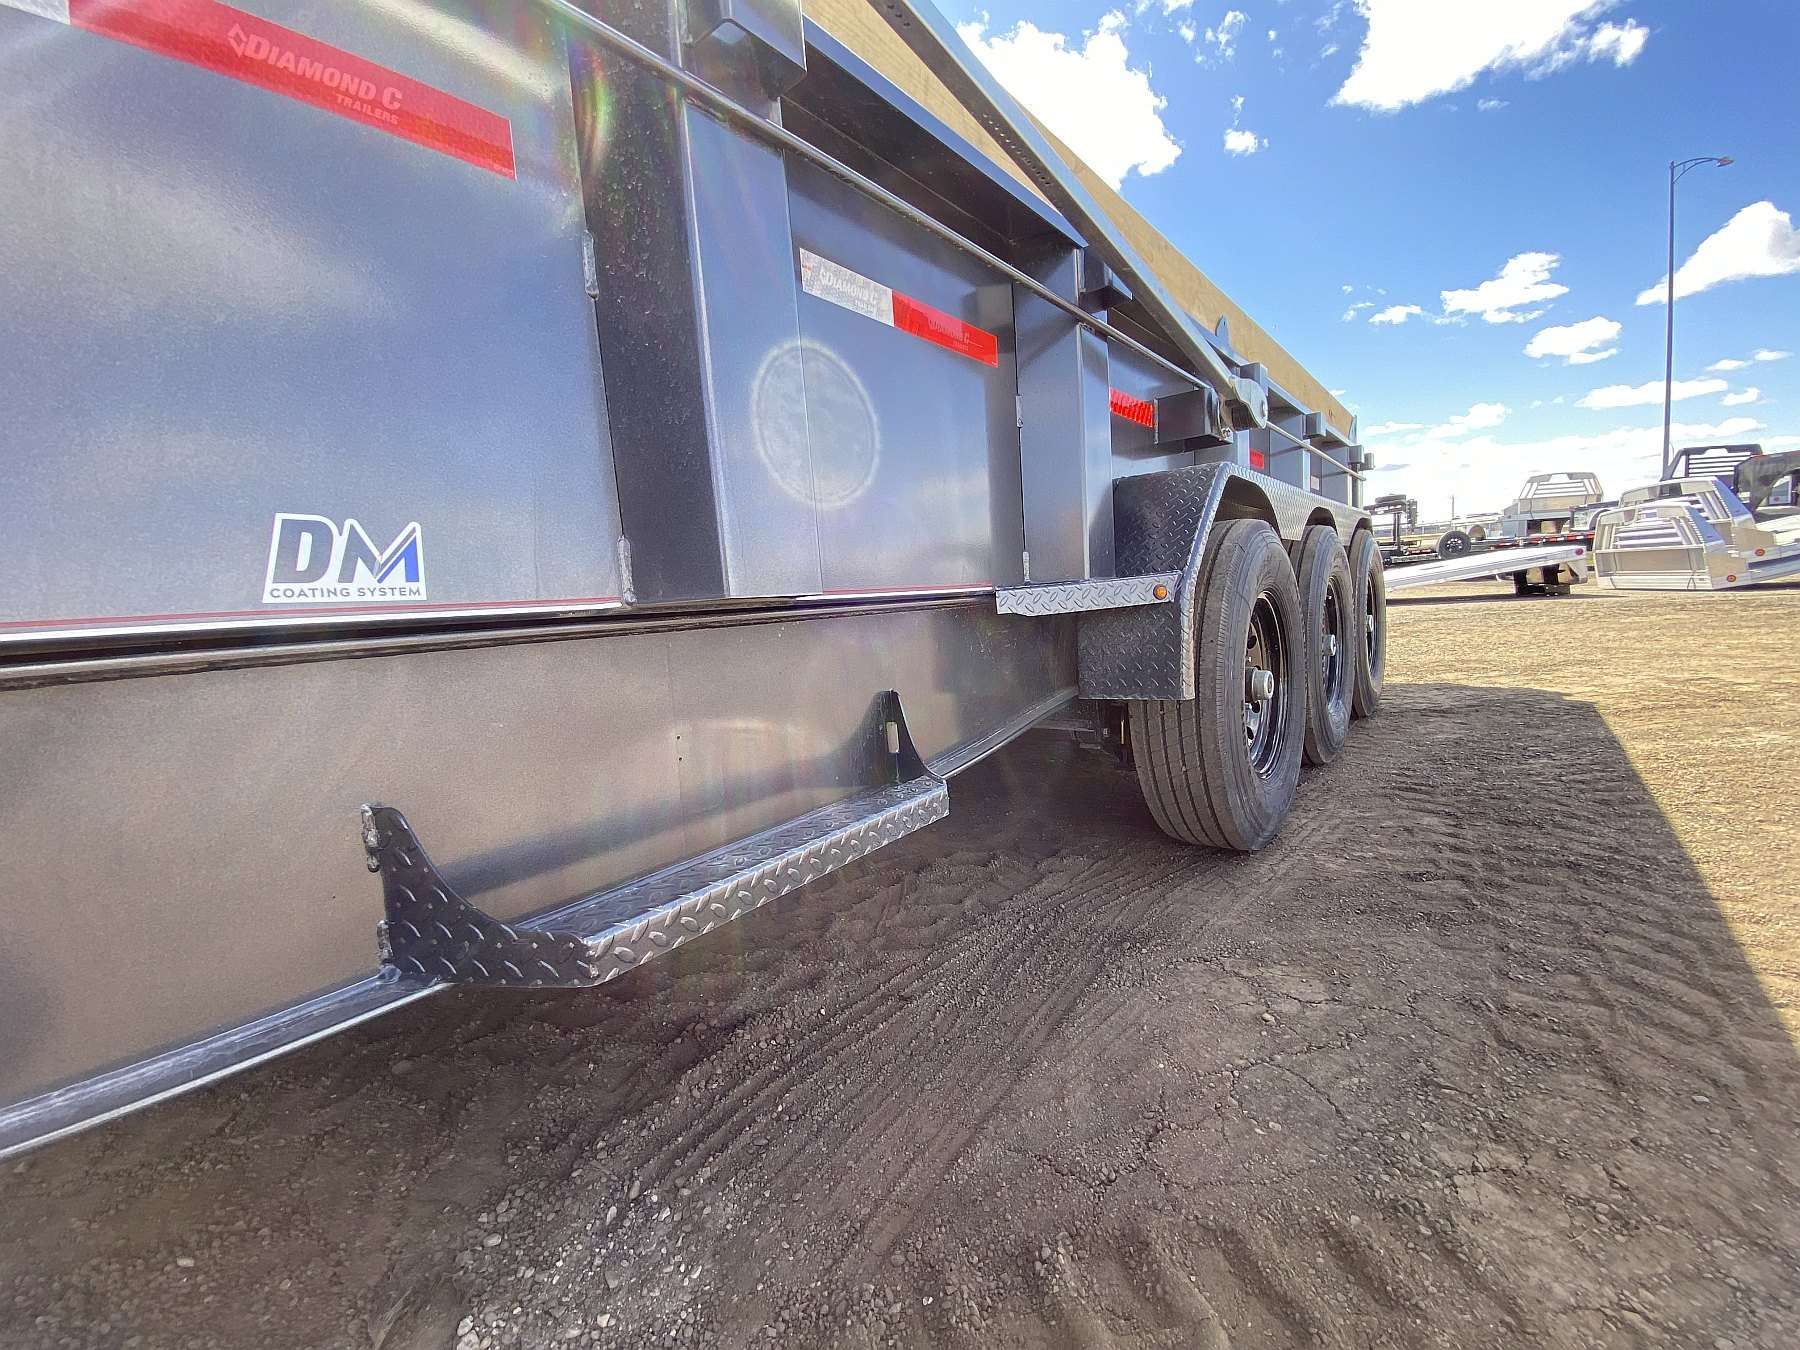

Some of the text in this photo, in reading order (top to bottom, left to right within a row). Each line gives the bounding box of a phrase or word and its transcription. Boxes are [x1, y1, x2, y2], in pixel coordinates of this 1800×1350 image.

[244, 33, 403, 111] DIAMOND C
[335, 92, 400, 126] TRAILERS
[271, 518, 420, 584] DM
[269, 586, 421, 599] COATING SYSTEM
